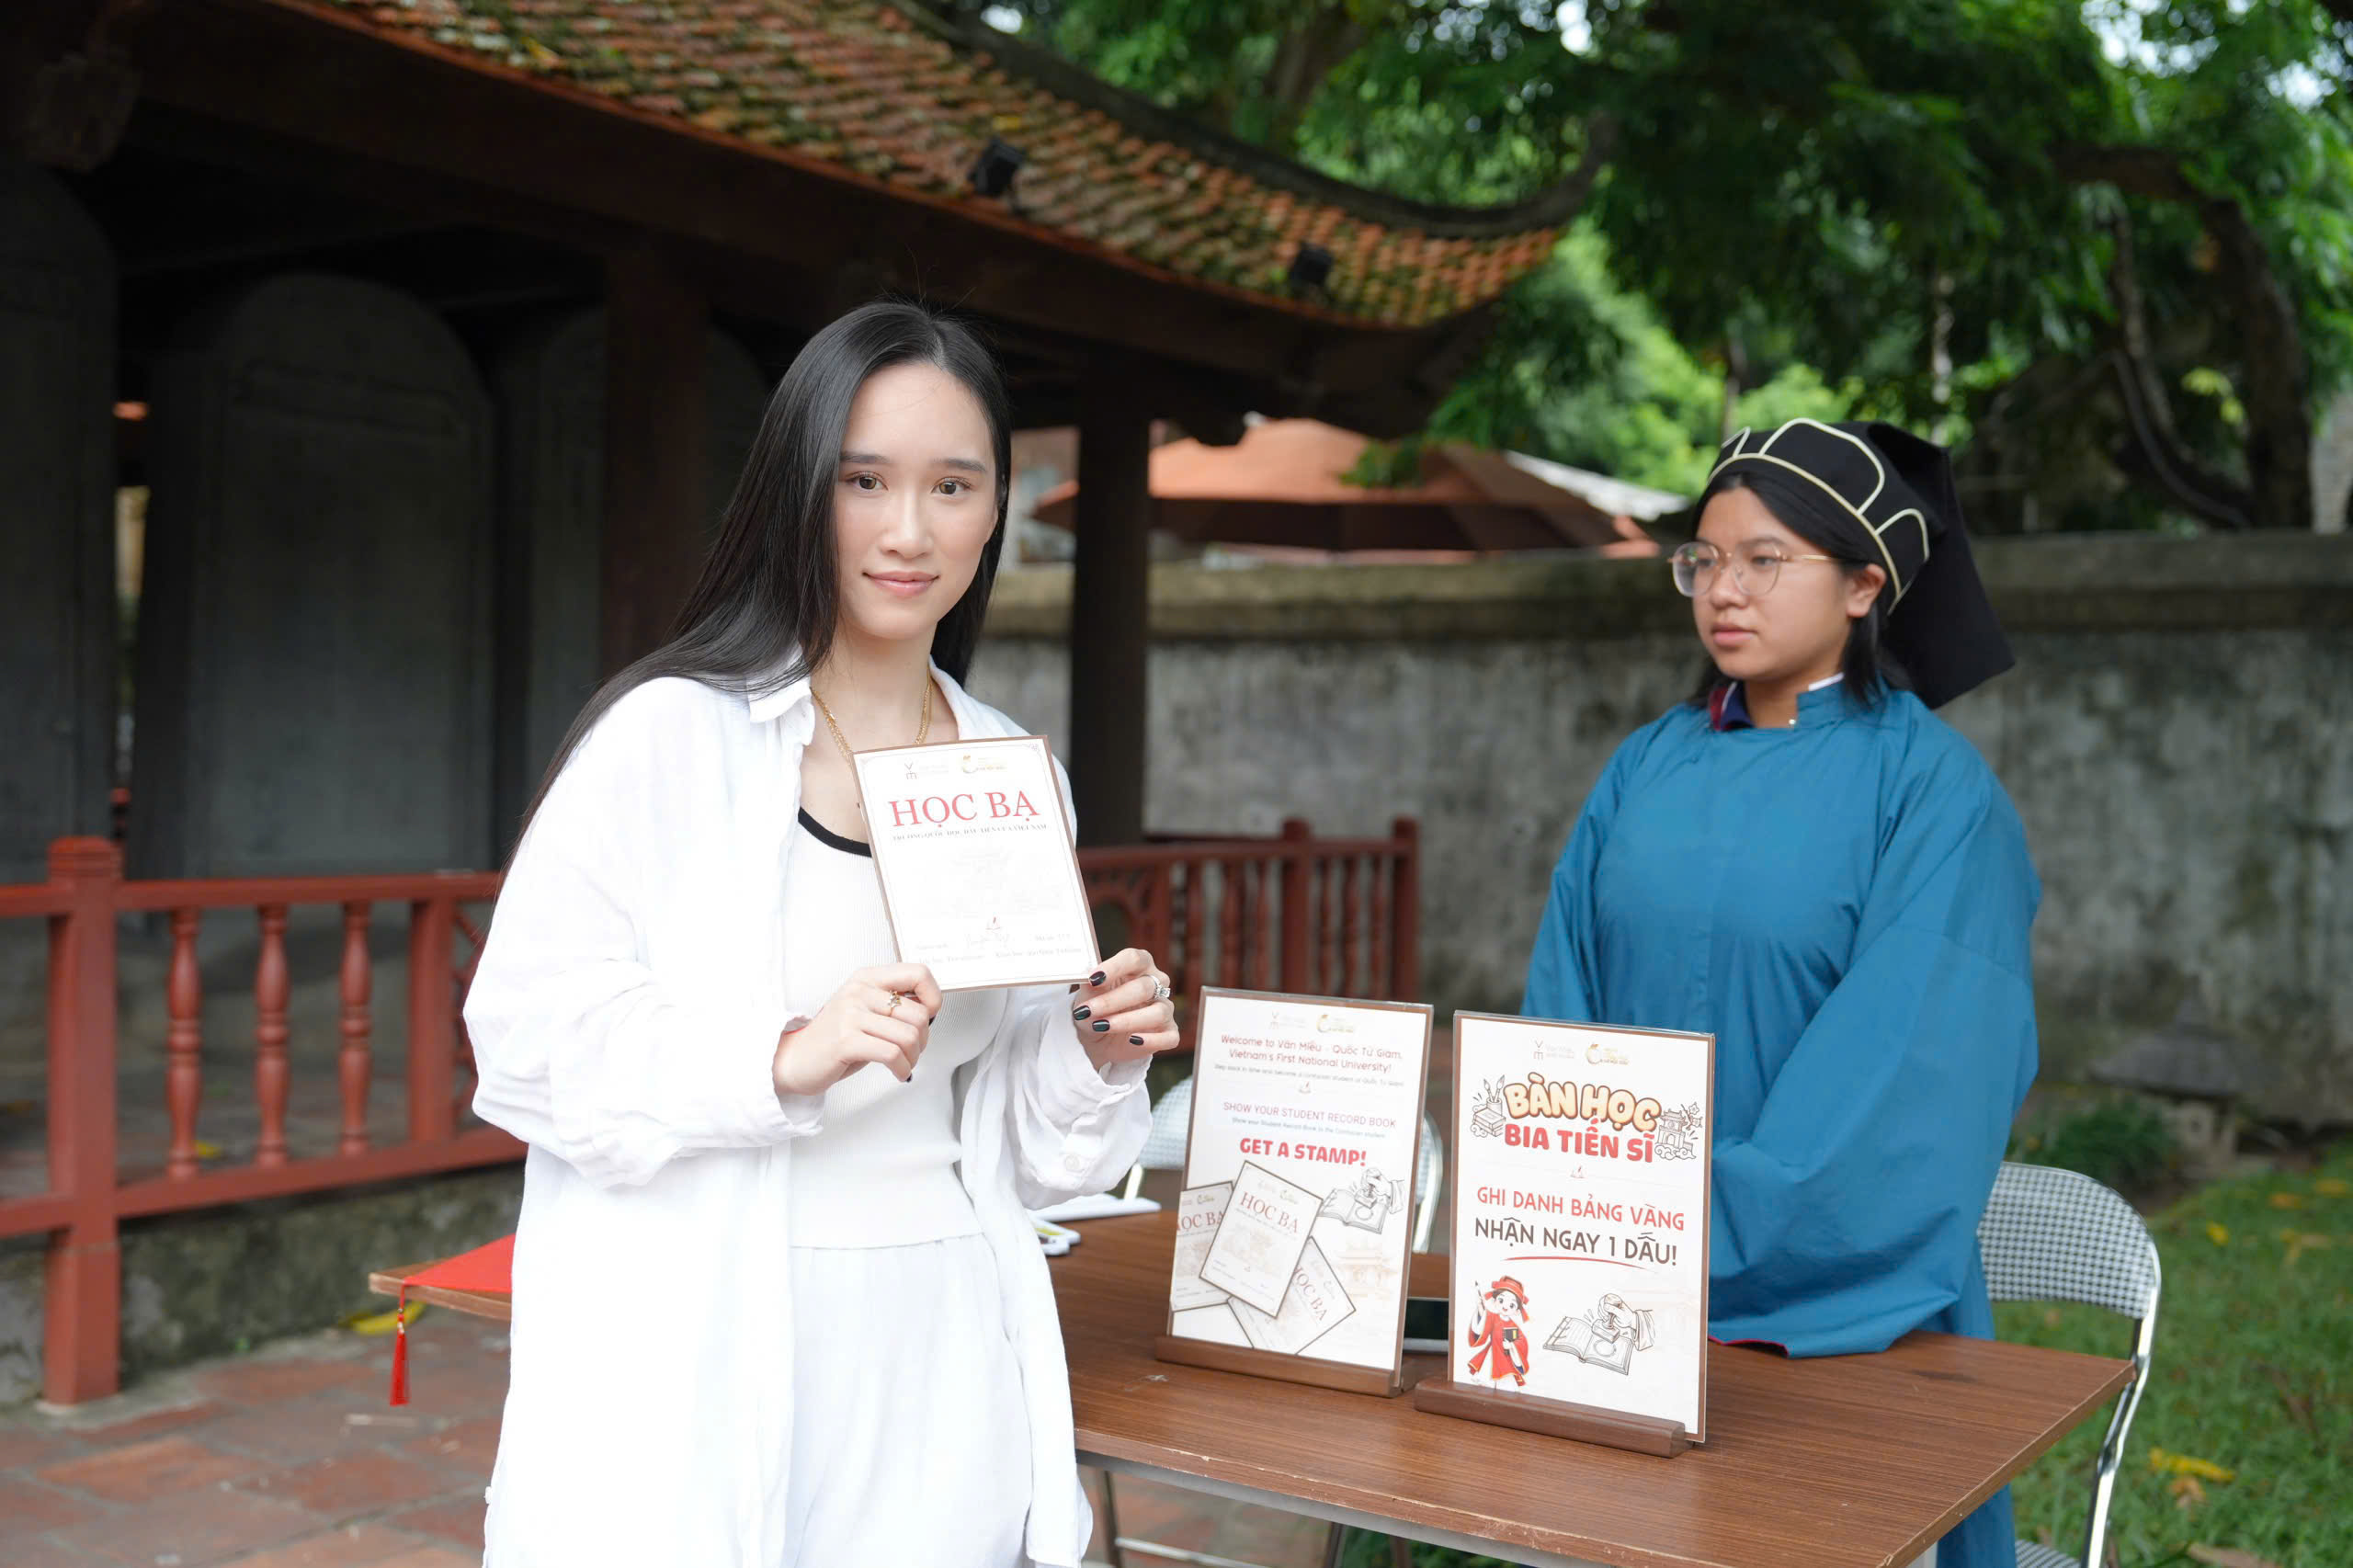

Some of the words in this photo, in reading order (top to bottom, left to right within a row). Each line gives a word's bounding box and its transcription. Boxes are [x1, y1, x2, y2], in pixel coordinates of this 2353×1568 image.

[889, 793, 978, 827] HỌC
[984, 790, 1040, 822] BẠ
[1222, 1035, 1262, 1046] Welcome
[1266, 1039, 1275, 1048] to
[1230, 1049, 1274, 1061] Vietnam's
[1277, 1052, 1295, 1063] First
[1299, 1055, 1338, 1067] National
[1341, 1059, 1392, 1074] University!
[1223, 1101, 1251, 1114] SHOW
[1254, 1104, 1279, 1117] YOUR
[1281, 1108, 1325, 1120] STUDENT
[1327, 1111, 1367, 1126] RECORD
[1369, 1115, 1397, 1129] BOOK
[1503, 1072, 1578, 1119] BÀN
[1580, 1084, 1662, 1132] HỌC
[1240, 1138, 1273, 1155] GET
[1277, 1142, 1290, 1156] A
[1293, 1143, 1367, 1166] STAMP!
[1505, 1123, 1550, 1151] BIA
[1557, 1118, 1619, 1160] TIẾN
[1627, 1131, 1654, 1163] SĨ
[1177, 1213, 1202, 1233] ỌC
[1477, 1187, 1506, 1206] GHI
[1513, 1190, 1563, 1214] DANH
[1571, 1193, 1623, 1222] BẢNG
[1630, 1203, 1685, 1232] VÀNG
[1474, 1216, 1534, 1247] NHẬN
[1542, 1227, 1600, 1254] NGAY
[1608, 1236, 1616, 1257] 1
[1624, 1232, 1677, 1266] DẤU!
